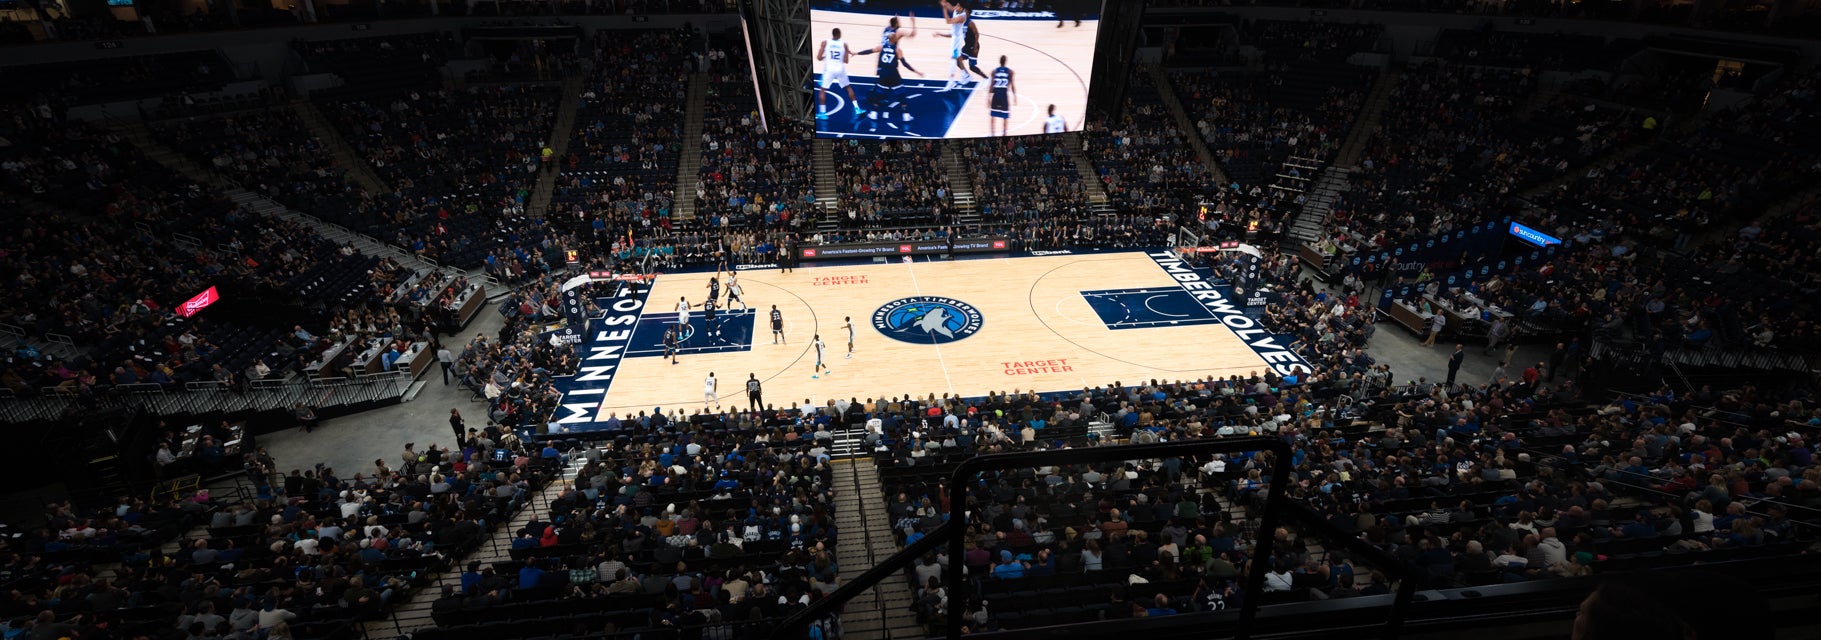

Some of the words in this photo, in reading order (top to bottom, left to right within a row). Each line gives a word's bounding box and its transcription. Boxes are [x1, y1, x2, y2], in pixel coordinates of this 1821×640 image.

[830, 50, 841, 60] 12
[881, 53, 895, 64] 67
[875, 298, 918, 330] MINNESOTA
[924, 297, 980, 335] TIMBERWOLVES
[1150, 250, 1312, 378] TIMBERWOLVES
[1000, 359, 1068, 369] TARGET
[1004, 365, 1074, 376] CENTER
